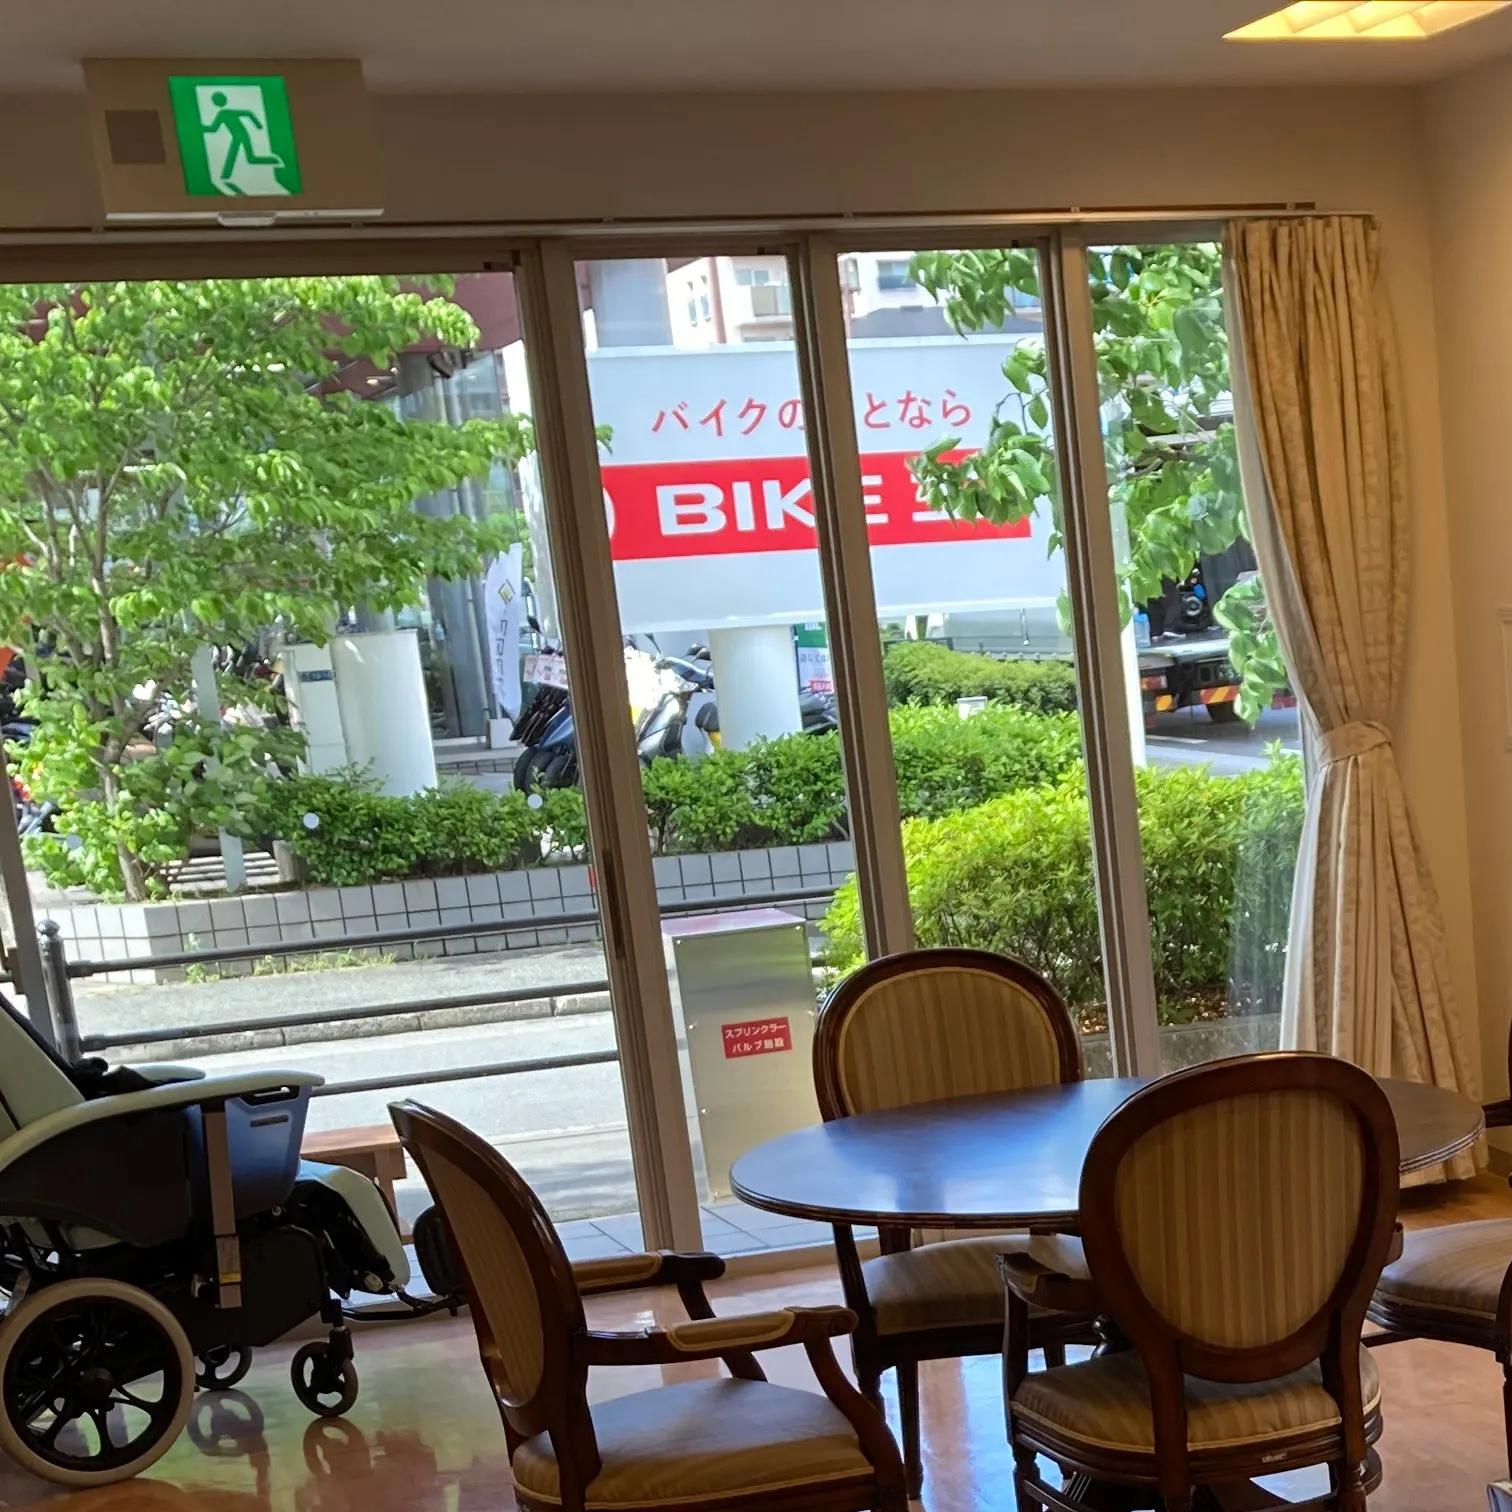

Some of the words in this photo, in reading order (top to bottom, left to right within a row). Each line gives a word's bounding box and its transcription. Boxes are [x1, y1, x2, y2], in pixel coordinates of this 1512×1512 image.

[651, 388, 973, 437] バイクのとなら
